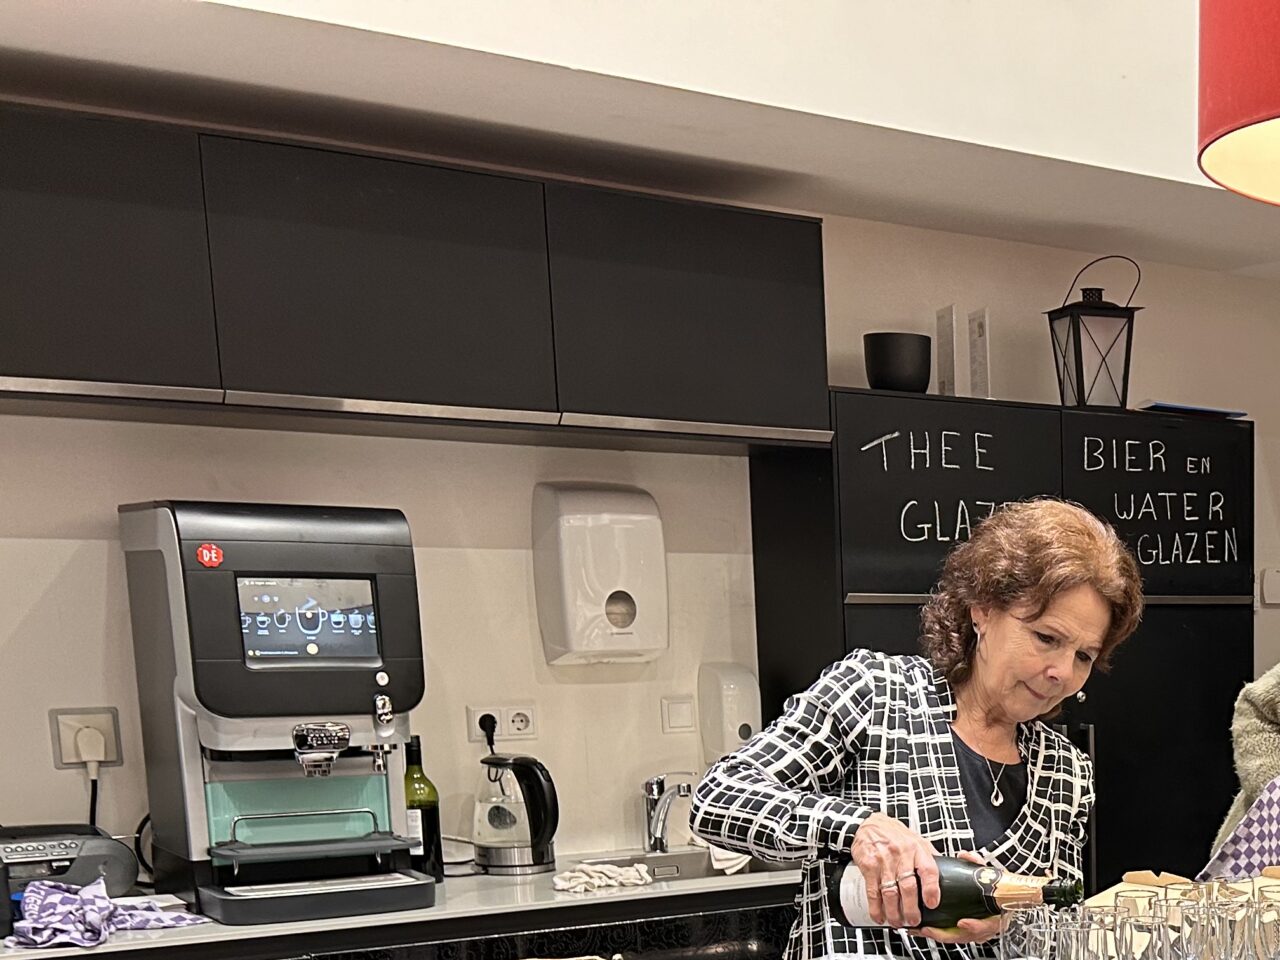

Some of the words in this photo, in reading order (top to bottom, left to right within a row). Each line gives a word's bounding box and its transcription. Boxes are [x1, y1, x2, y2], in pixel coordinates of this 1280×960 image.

[861, 431, 994, 471] THEE
[1084, 437, 1166, 472] BIER
[1186, 457, 1210, 475] EN
[1114, 492, 1225, 521] WATER
[1137, 528, 1238, 565] GLAZEN
